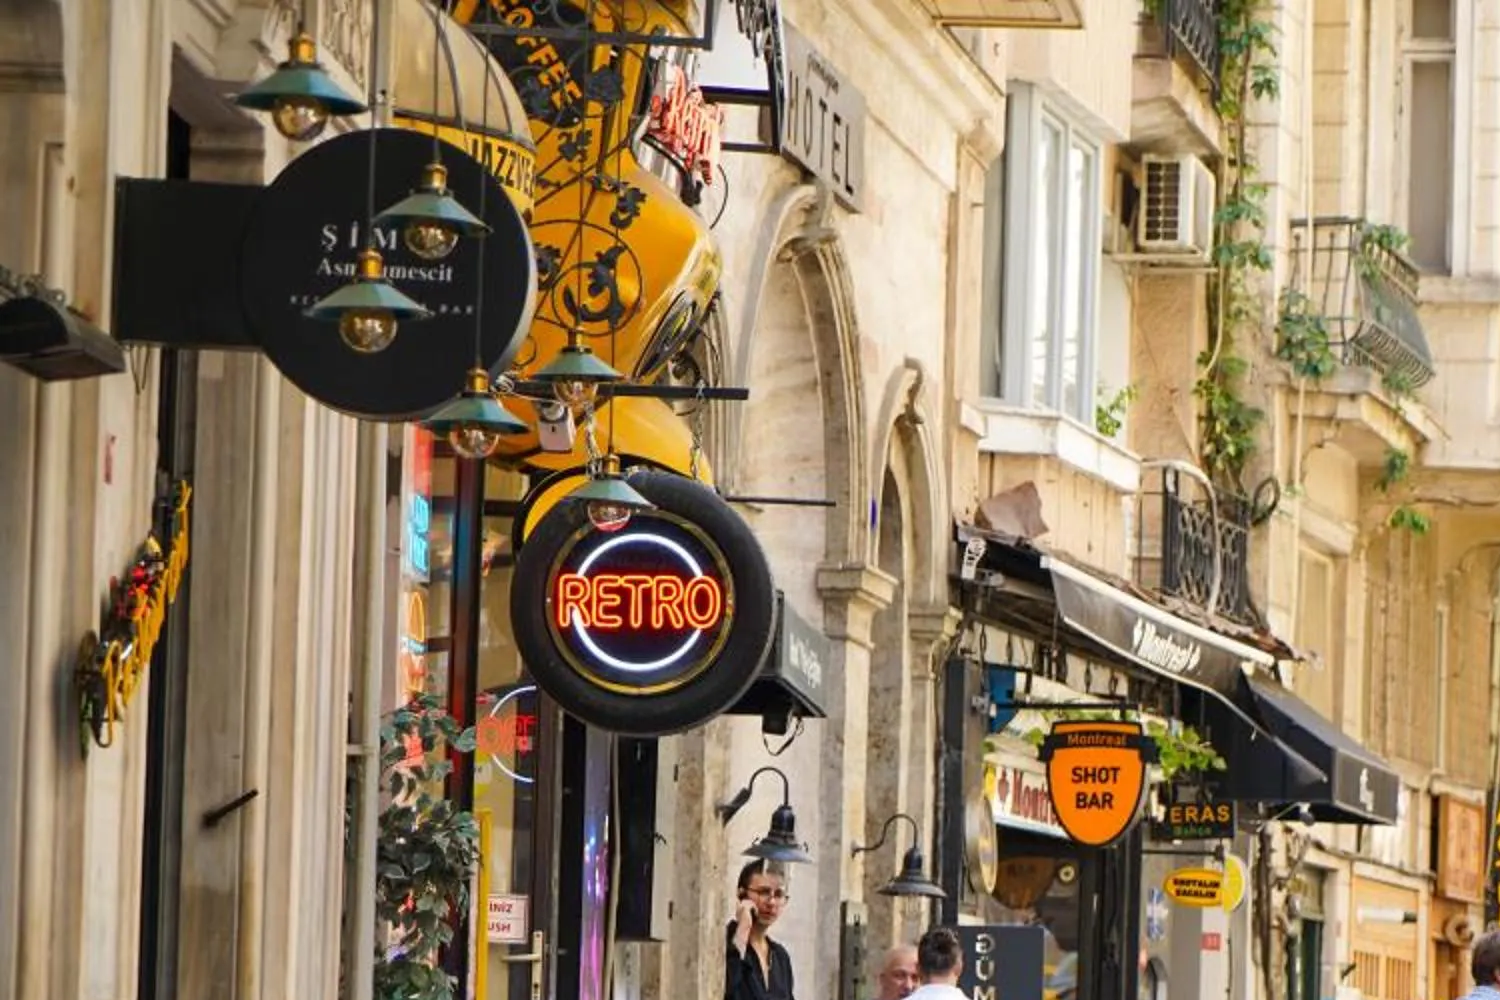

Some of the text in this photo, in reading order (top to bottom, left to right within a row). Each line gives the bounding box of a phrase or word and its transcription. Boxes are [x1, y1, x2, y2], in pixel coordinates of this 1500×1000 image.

[787, 70, 853, 196] HOTEL
[320, 221, 397, 251] ŞİM
[558, 573, 721, 629] RETRO
[1066, 733, 1127, 746] Montreal
[1070, 766, 1121, 785] SHOT
[1074, 791, 1114, 810] BAR
[1169, 804, 1231, 824] ERAS
